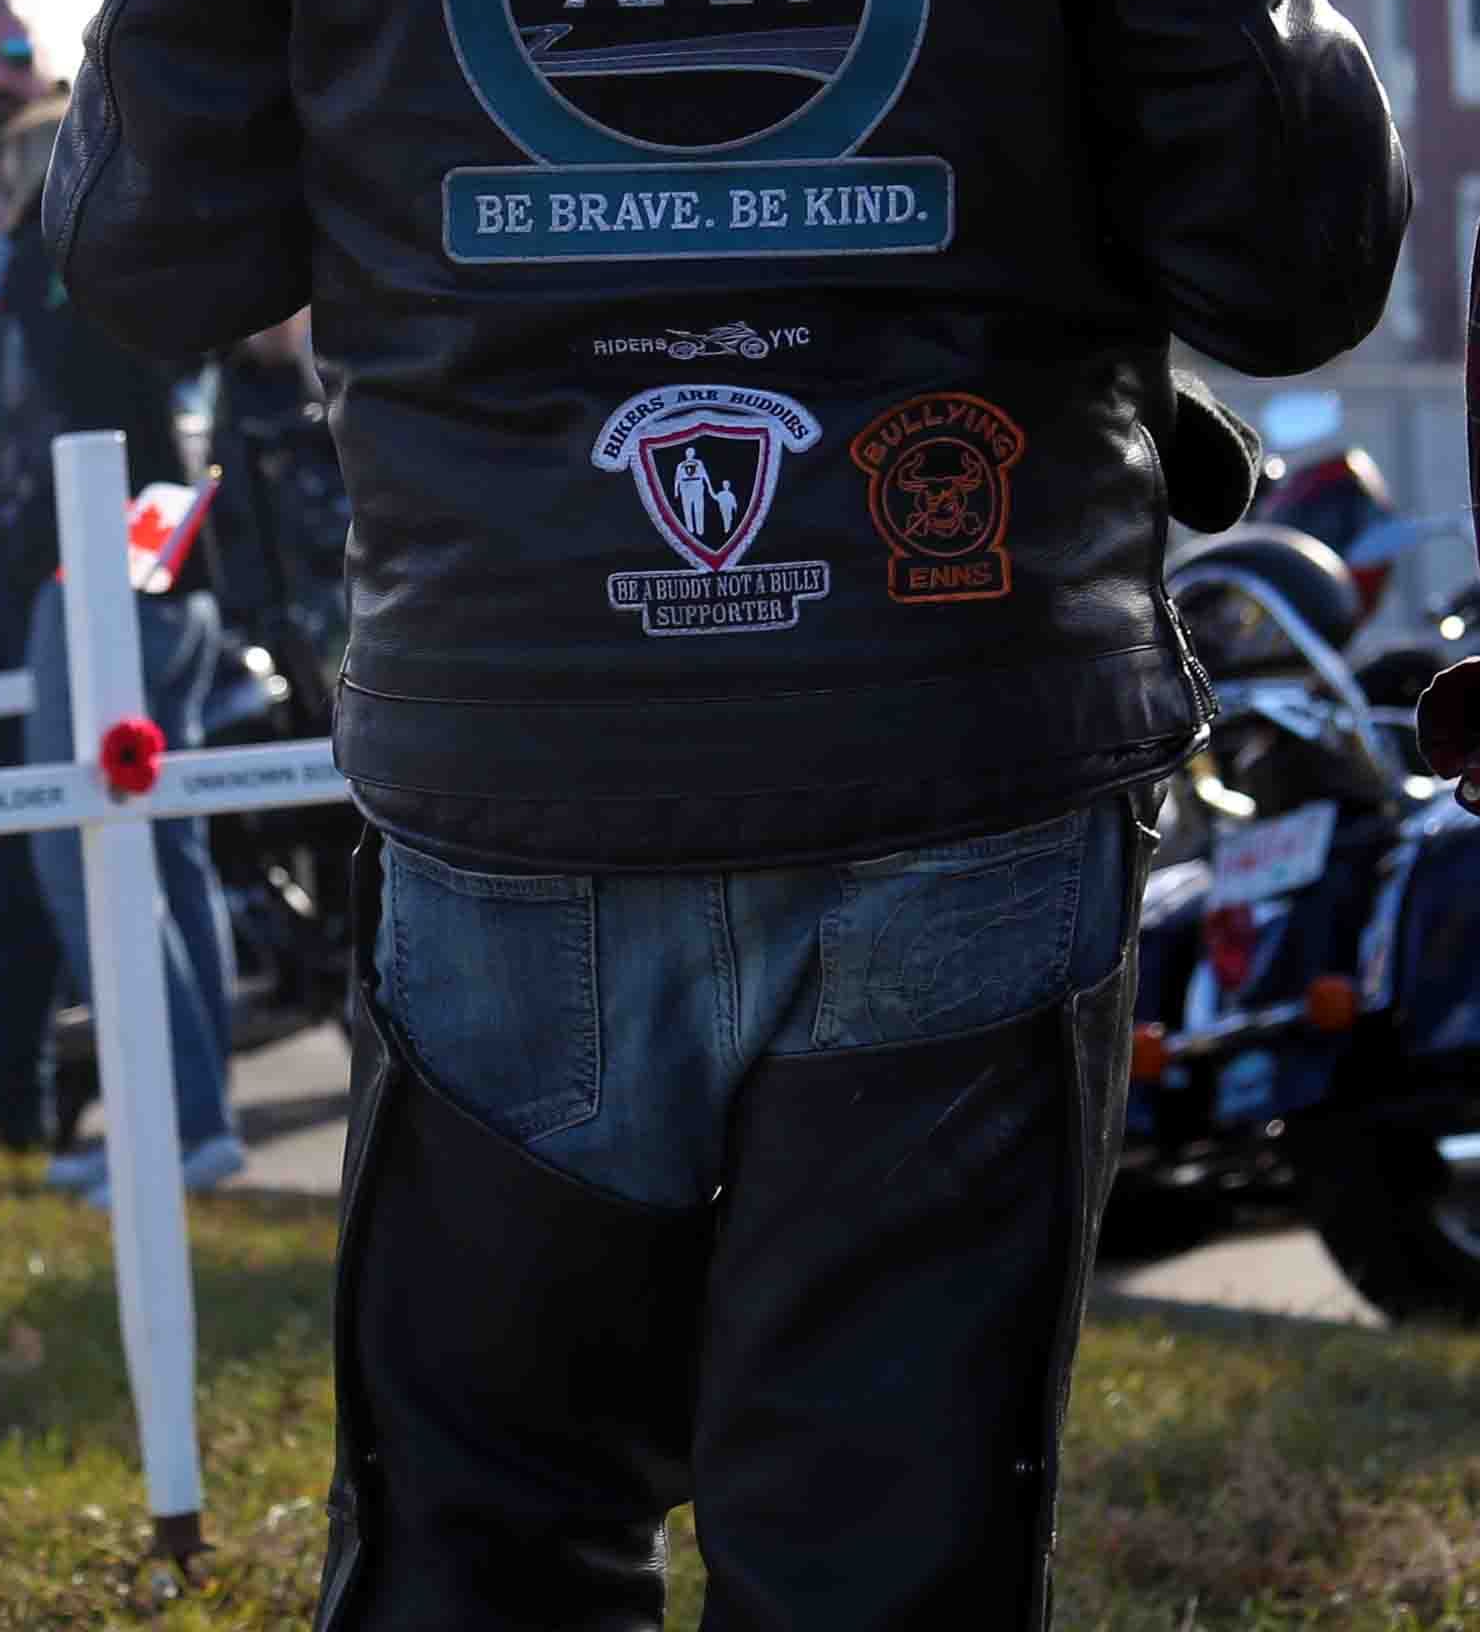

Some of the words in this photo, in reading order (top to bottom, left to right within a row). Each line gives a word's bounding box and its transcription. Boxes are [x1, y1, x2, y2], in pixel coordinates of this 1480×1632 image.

[474, 194, 533, 235] BE
[547, 191, 716, 234] BRAVE.
[728, 188, 788, 230] BE
[803, 183, 929, 227] KIND.
[593, 337, 668, 356] RIDERS
[769, 326, 811, 349] YYC
[603, 394, 665, 460] BIKERS
[675, 389, 720, 403] ARE
[727, 390, 810, 441] BUDDIES
[863, 400, 1016, 465] BULLYING
[616, 579, 640, 601] BE
[642, 579, 655, 601] A
[655, 578, 713, 600] BUDDY
[716, 574, 752, 597] NOT
[756, 573, 769, 595] A
[769, 569, 822, 593] BULLY
[655, 599, 785, 627] SUPPORTER
[182, 768, 294, 795] UNKNOWN
